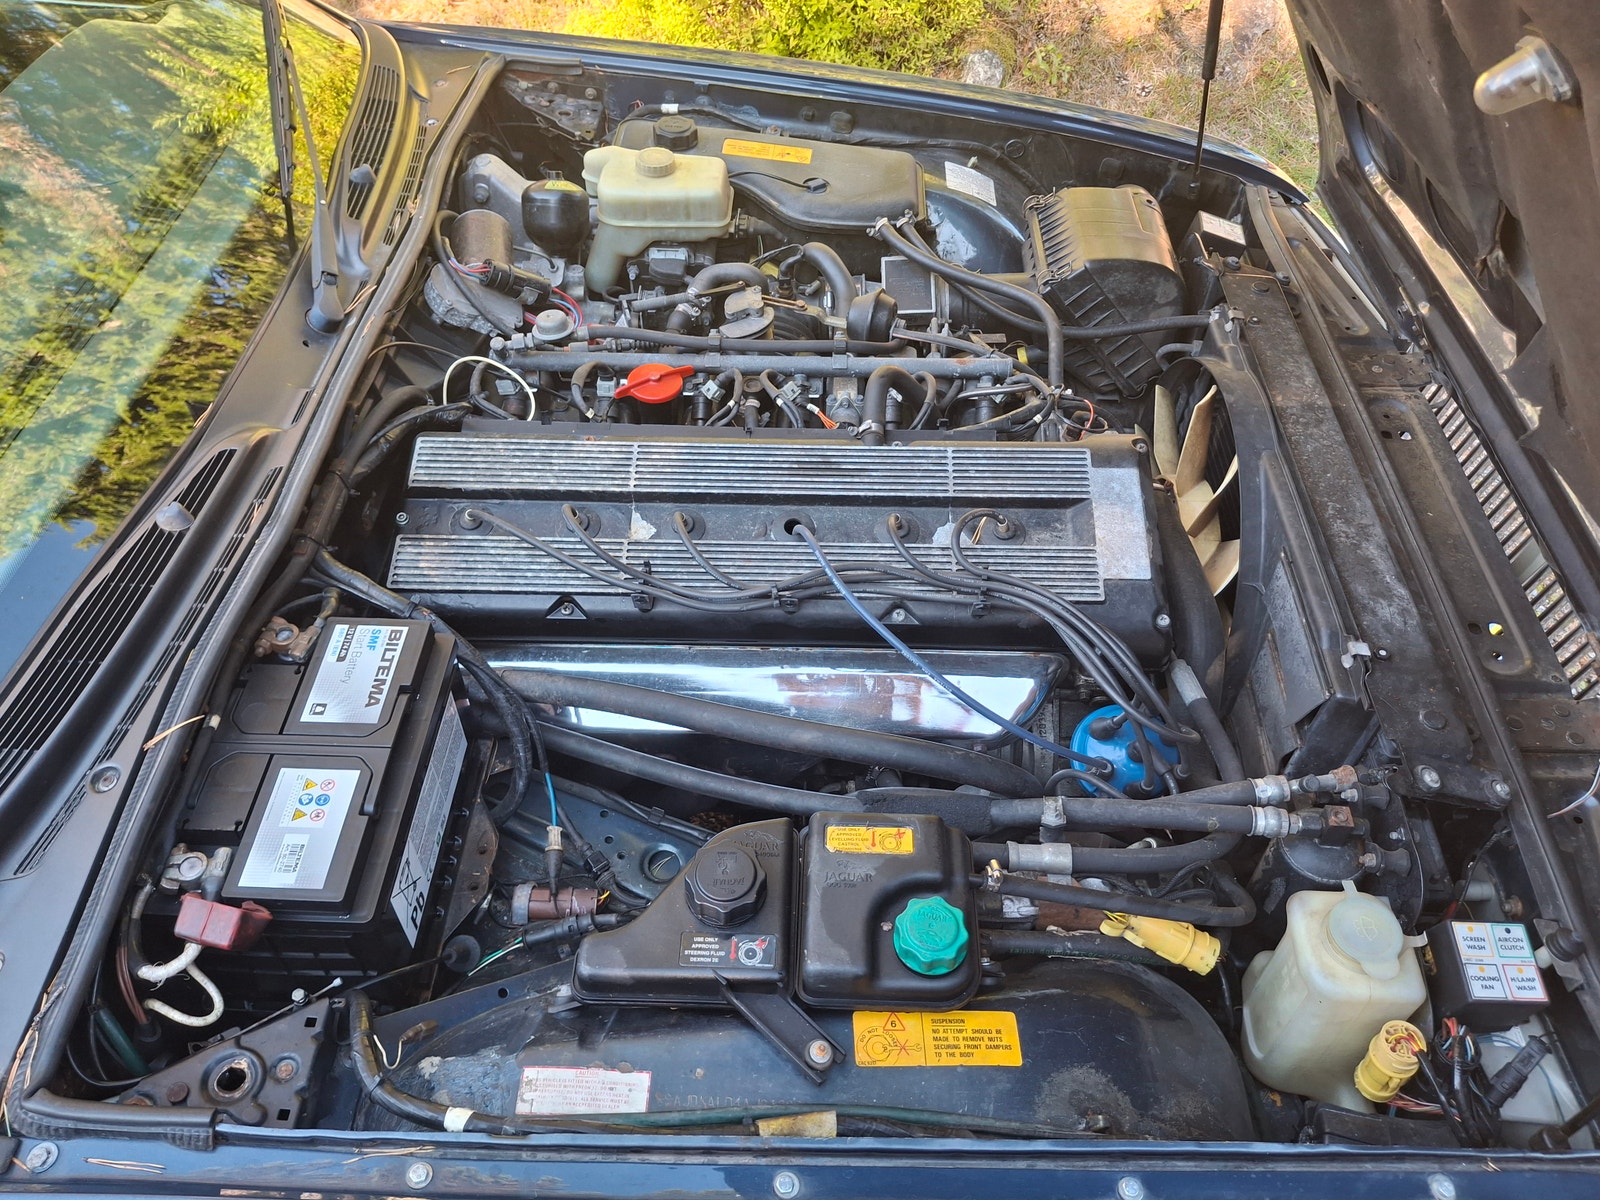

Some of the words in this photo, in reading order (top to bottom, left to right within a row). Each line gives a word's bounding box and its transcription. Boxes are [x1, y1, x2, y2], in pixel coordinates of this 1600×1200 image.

[352, 628, 370, 651] Start
[366, 628, 382, 652] SMF
[340, 651, 363, 685] Battery
[365, 629, 404, 708] BILTEMA
[824, 871, 873, 883] JAGUAR
[410, 891, 425, 931] Pb
[890, 1020, 897, 1028] 6
[859, 1034, 867, 1043] DO
